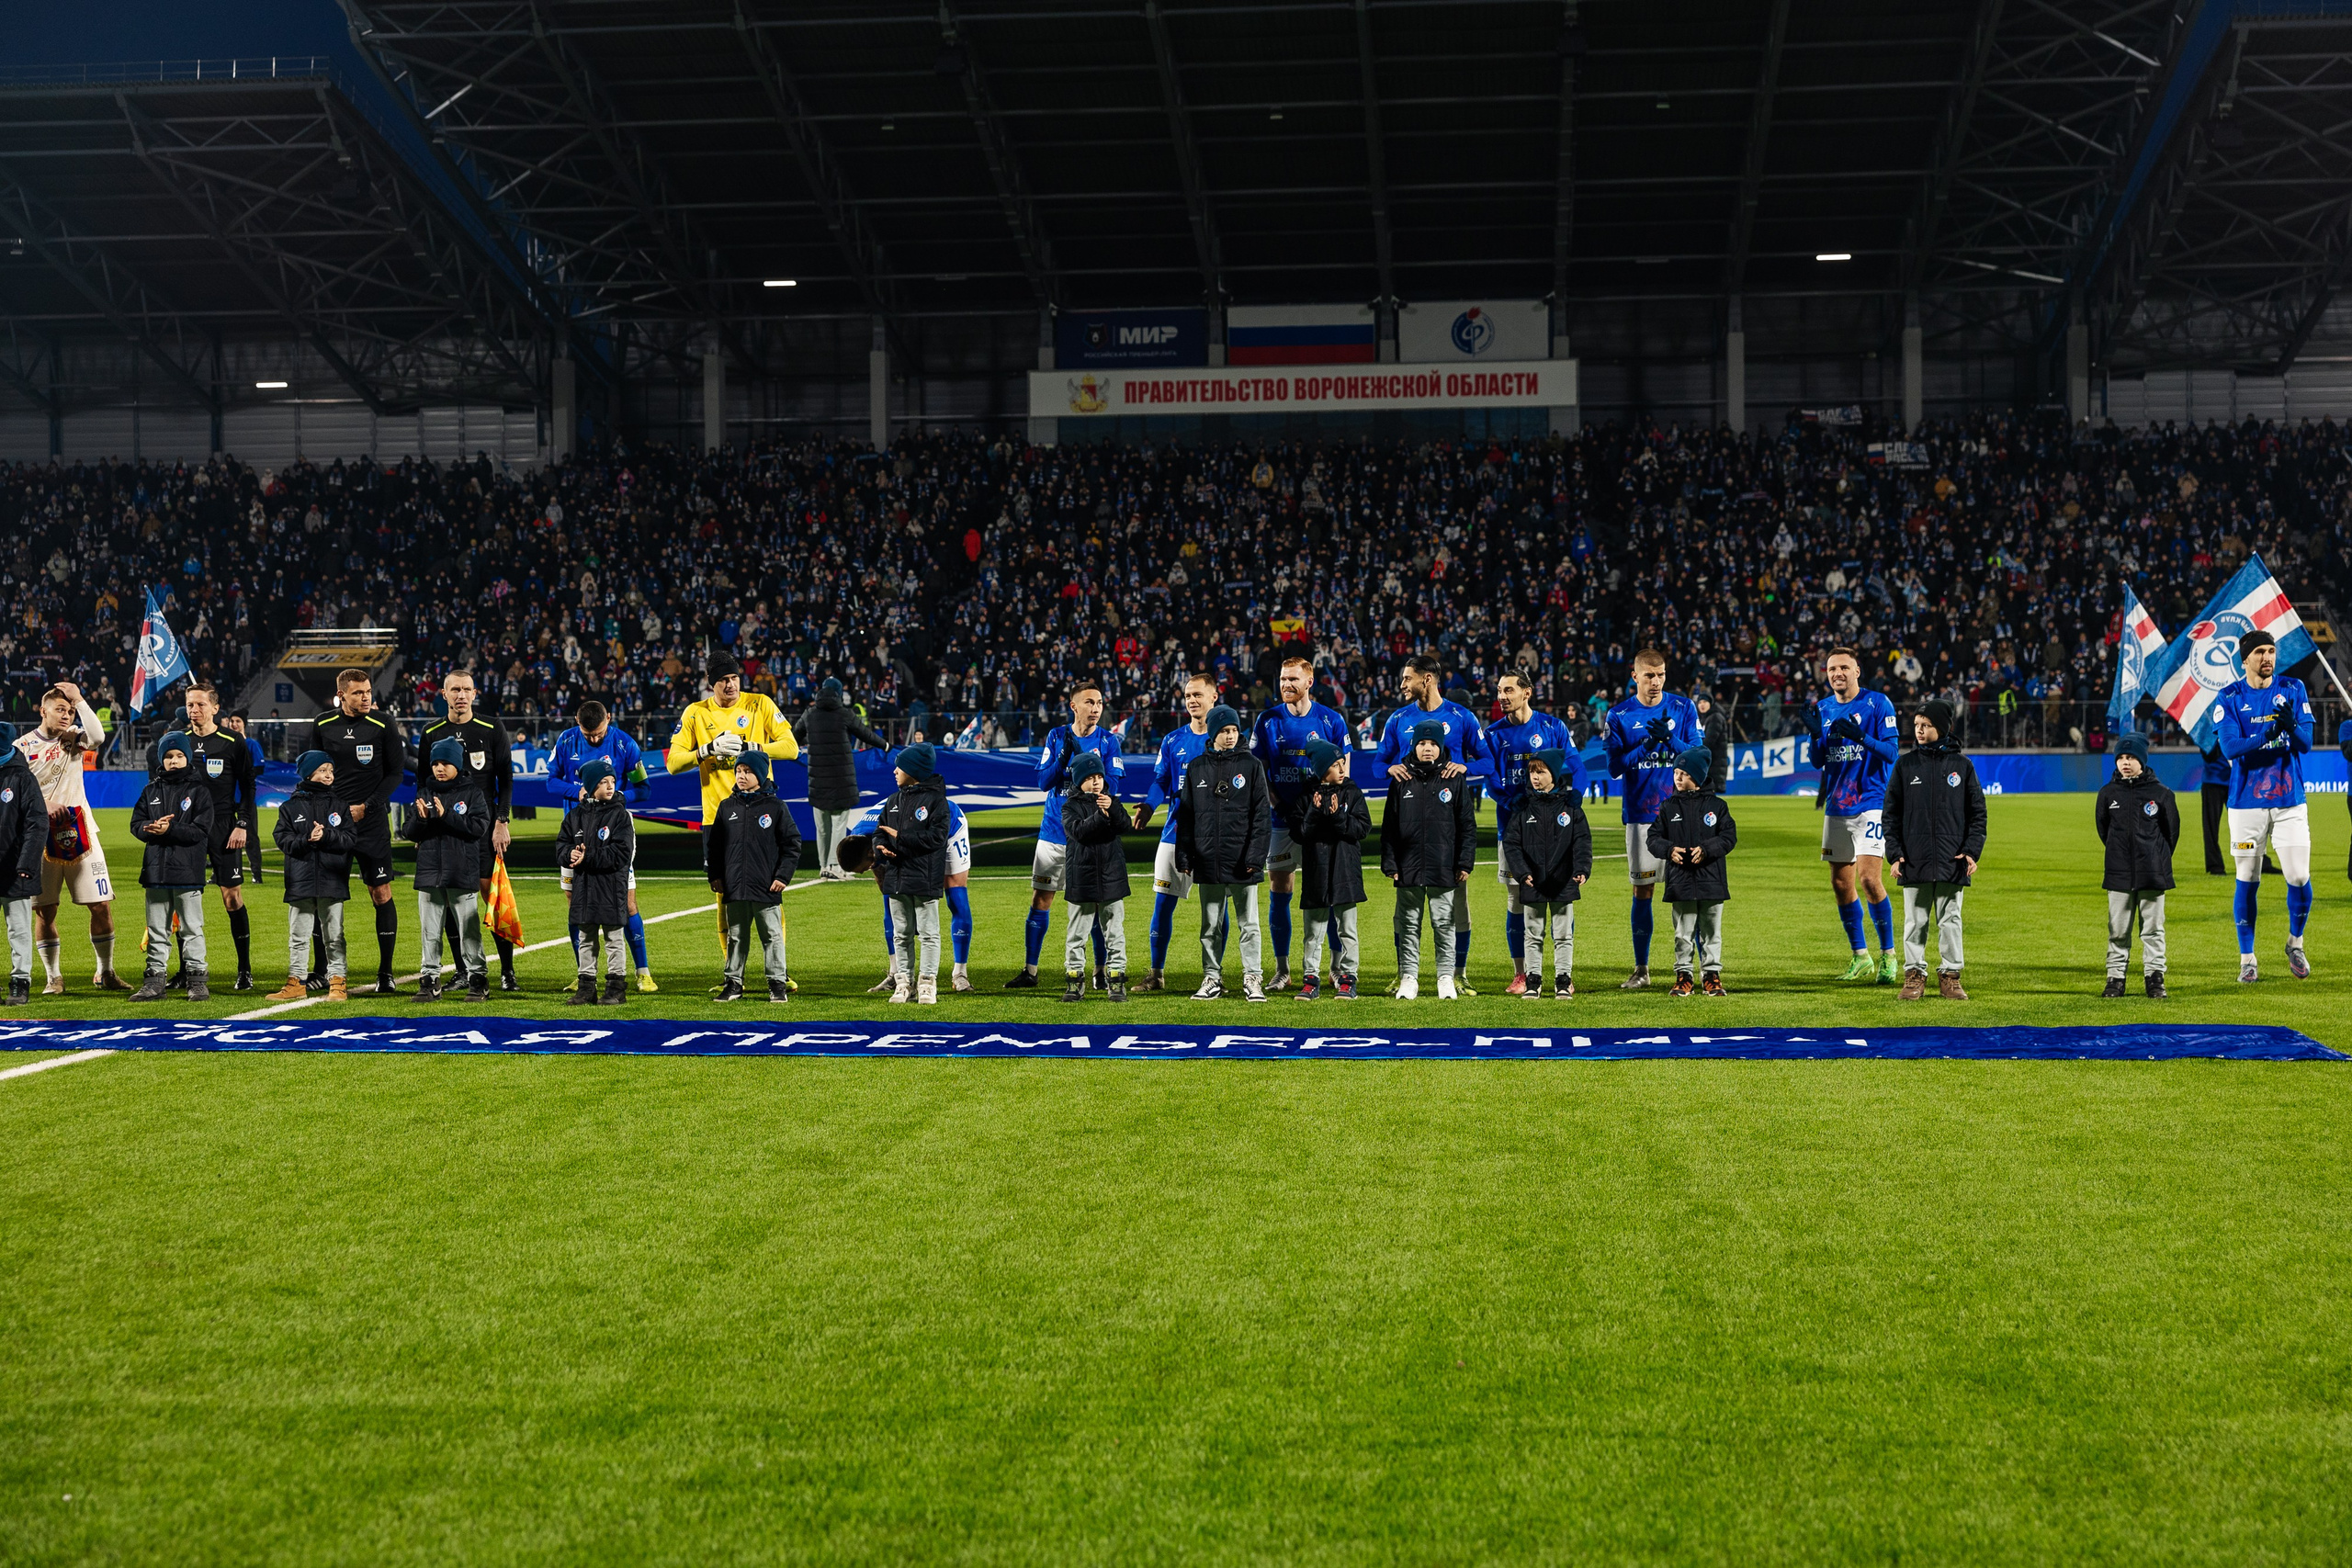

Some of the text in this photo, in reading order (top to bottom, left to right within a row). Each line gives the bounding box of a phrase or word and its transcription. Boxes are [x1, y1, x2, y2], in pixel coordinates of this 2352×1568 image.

[1119, 326, 1179, 344] МИР
[1124, 370, 1539, 404] ПРАВИТЕЛЬСТВО ВОРОНЕЖСКОЙ ОБЛАСТИ
[56, 829, 77, 840] ЦСКА
[1865, 821, 1883, 840] 20
[954, 838, 969, 859] 13
[96, 878, 108, 897] 10
[0, 1023, 614, 1046] ИЙСКАЯ
